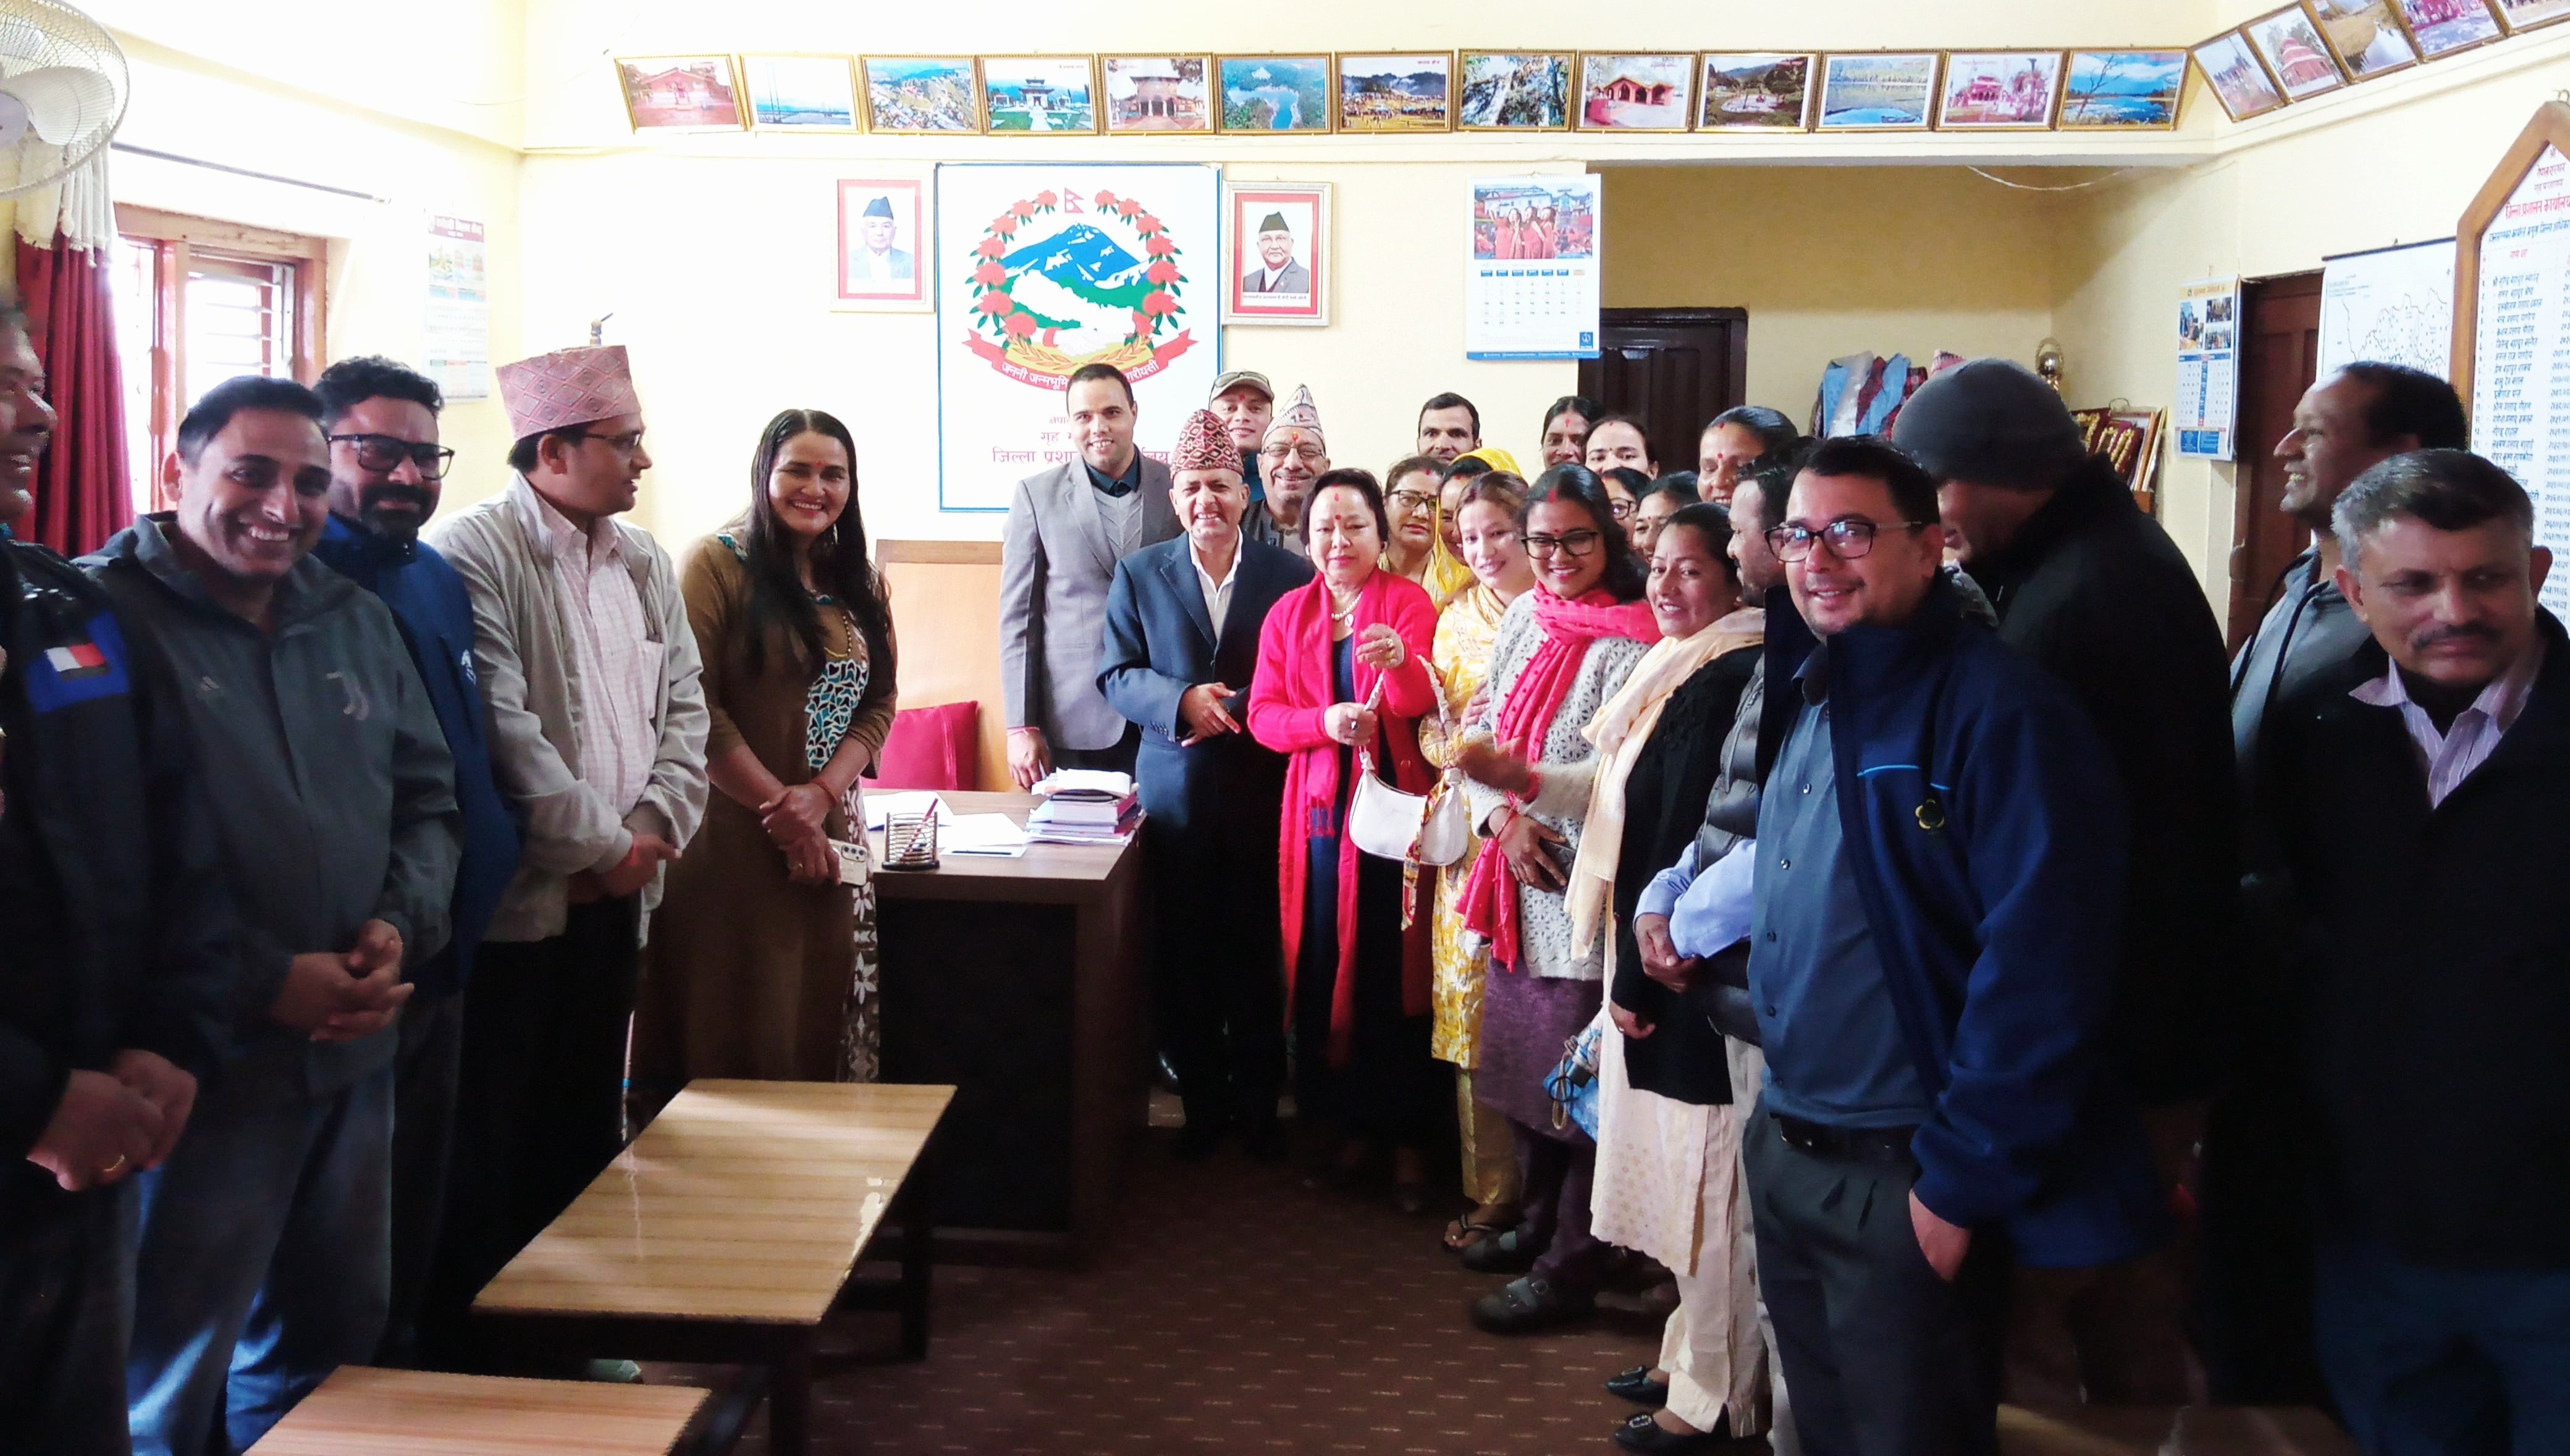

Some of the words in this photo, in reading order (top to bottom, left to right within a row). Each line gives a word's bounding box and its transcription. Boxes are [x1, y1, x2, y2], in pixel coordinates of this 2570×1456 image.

[1001, 361, 1028, 381] जननी
[1029, 372, 1069, 390] जन्मभूमि
[1040, 432, 1061, 445] गृह
[992, 446, 1036, 463] जिल्ला
[1043, 450, 1078, 463] प्रशा
